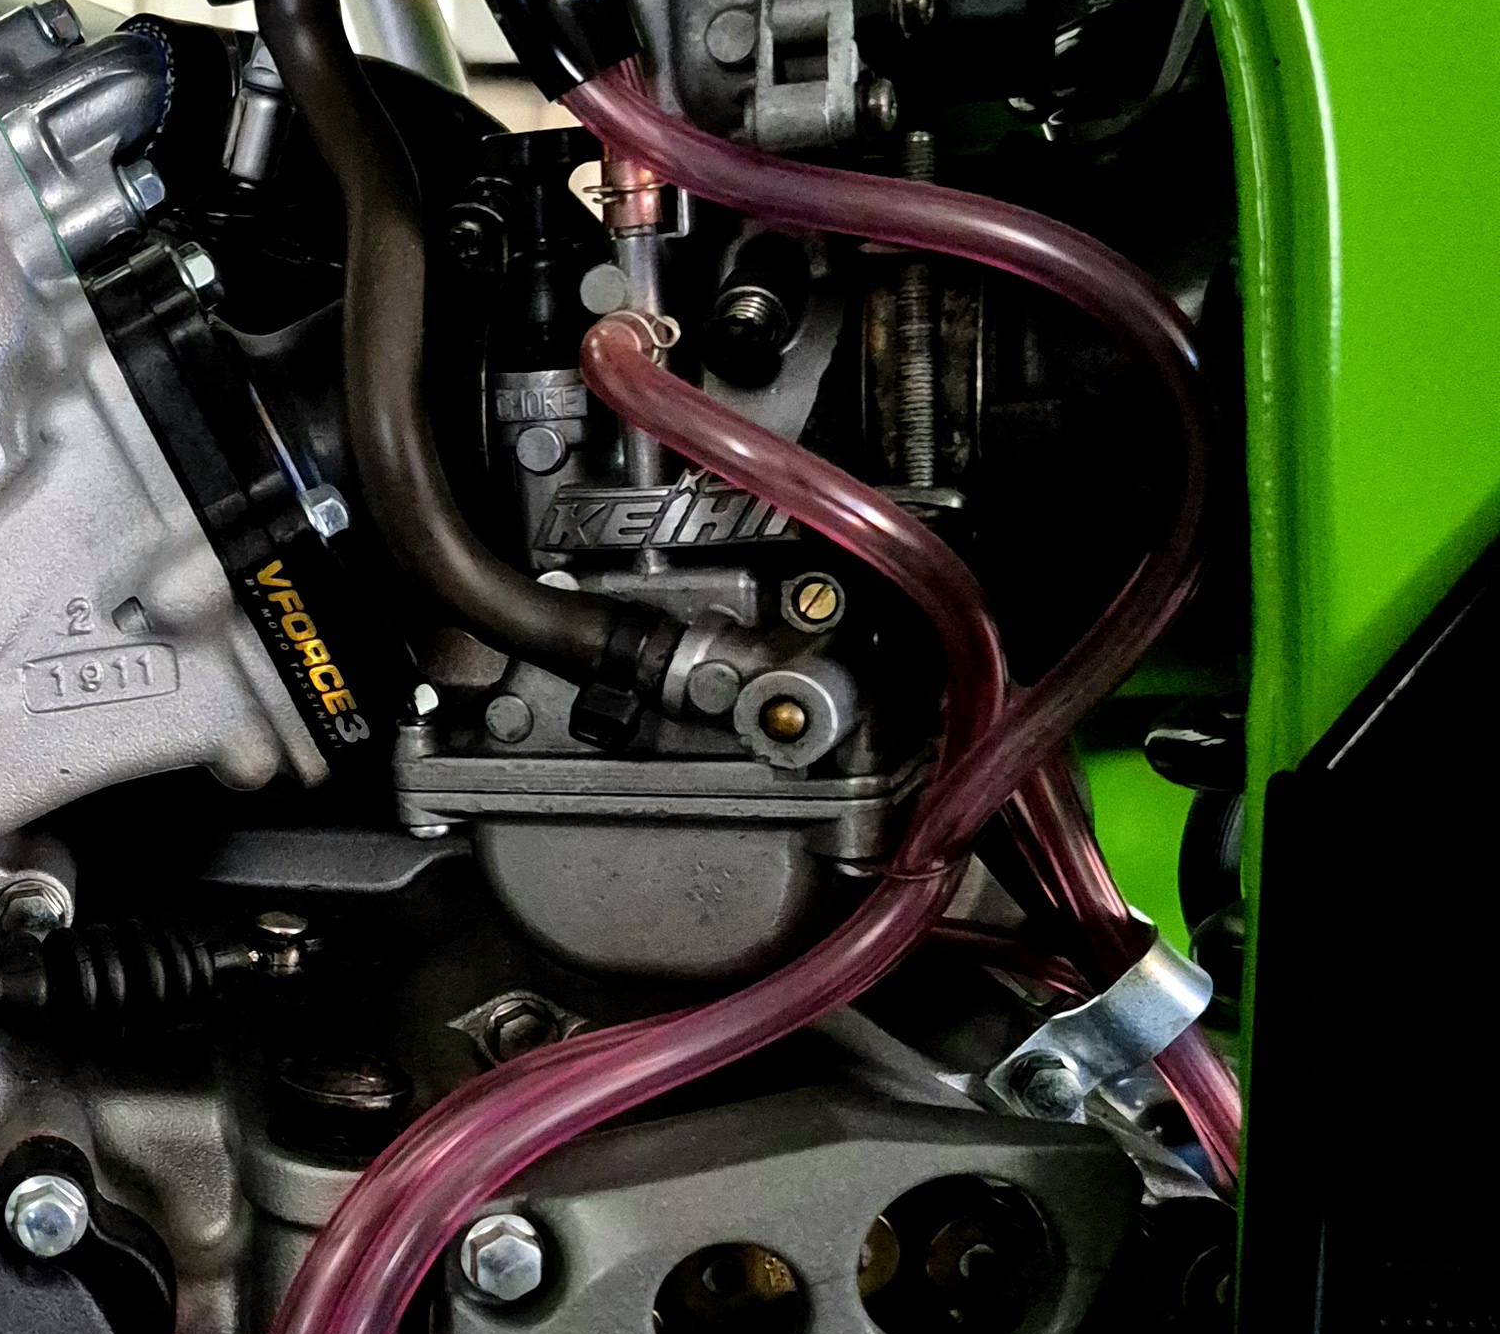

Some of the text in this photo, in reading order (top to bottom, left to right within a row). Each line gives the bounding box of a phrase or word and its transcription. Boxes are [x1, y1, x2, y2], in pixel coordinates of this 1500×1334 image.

[65, 596, 94, 636] 2
[244, 578, 262, 598] BY
[260, 607, 290, 652] MOTO
